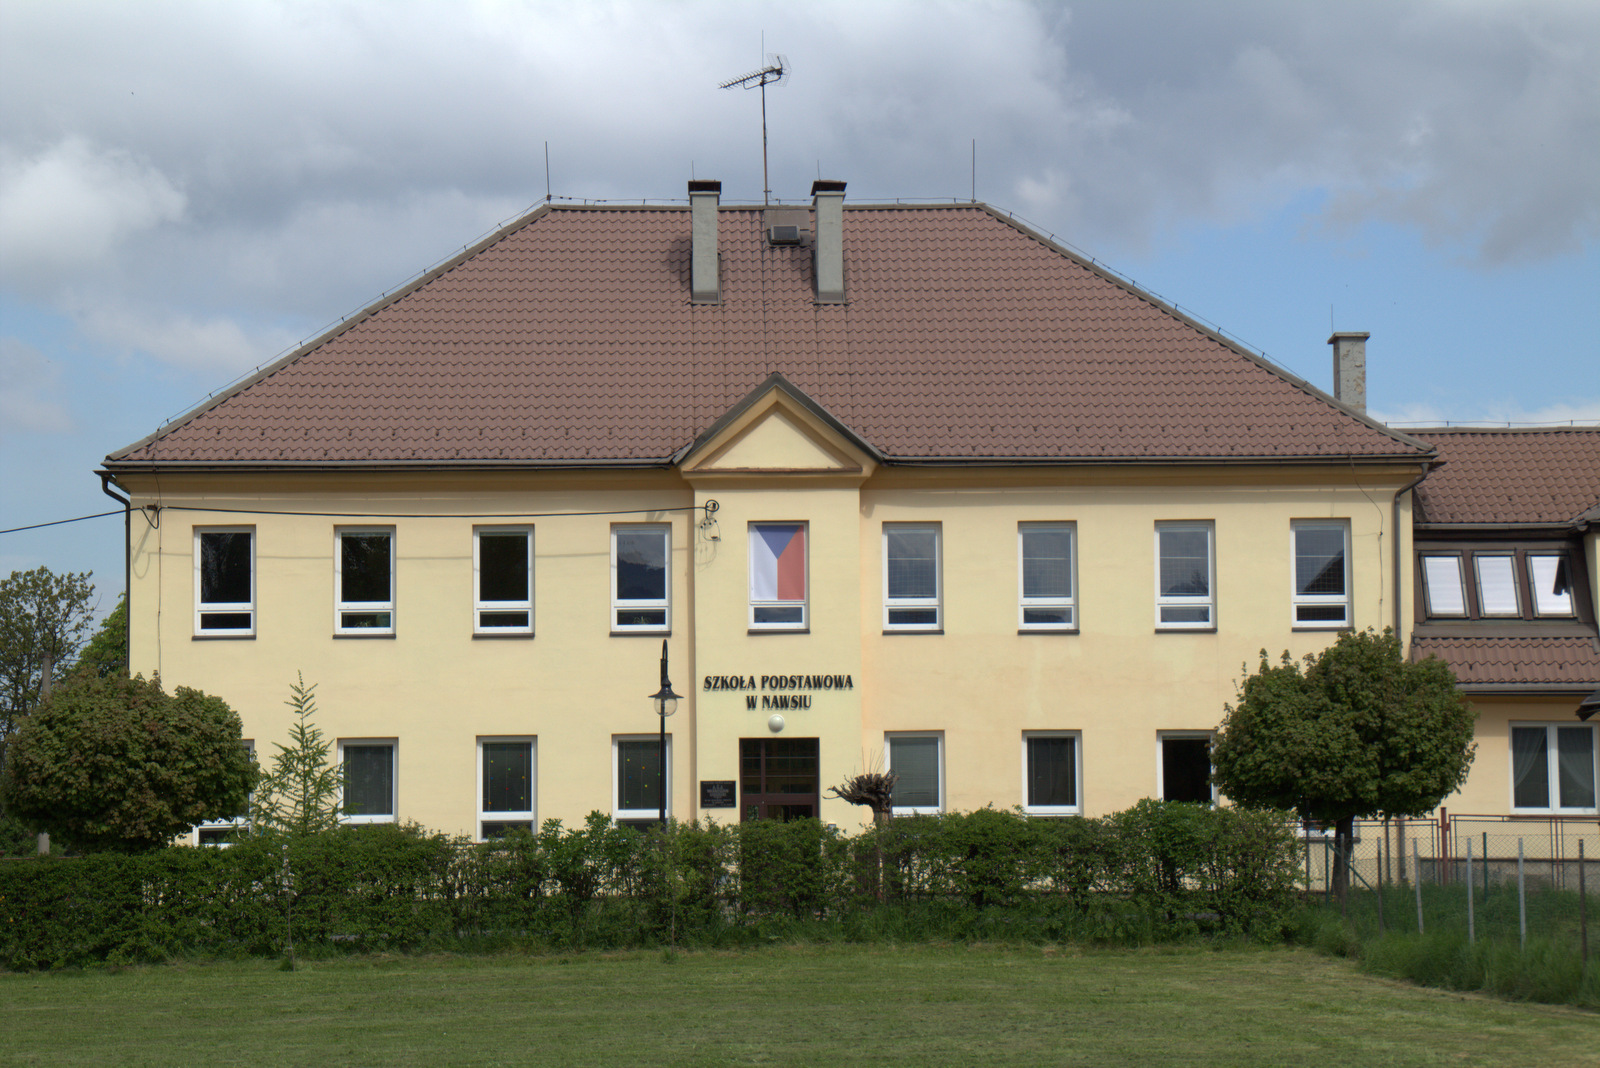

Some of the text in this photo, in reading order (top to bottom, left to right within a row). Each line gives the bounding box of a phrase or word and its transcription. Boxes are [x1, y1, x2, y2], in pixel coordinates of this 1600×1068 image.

[703, 674, 854, 690] SZKOŁA PODSTAWOWA
[746, 694, 812, 709] W NAWSIU
